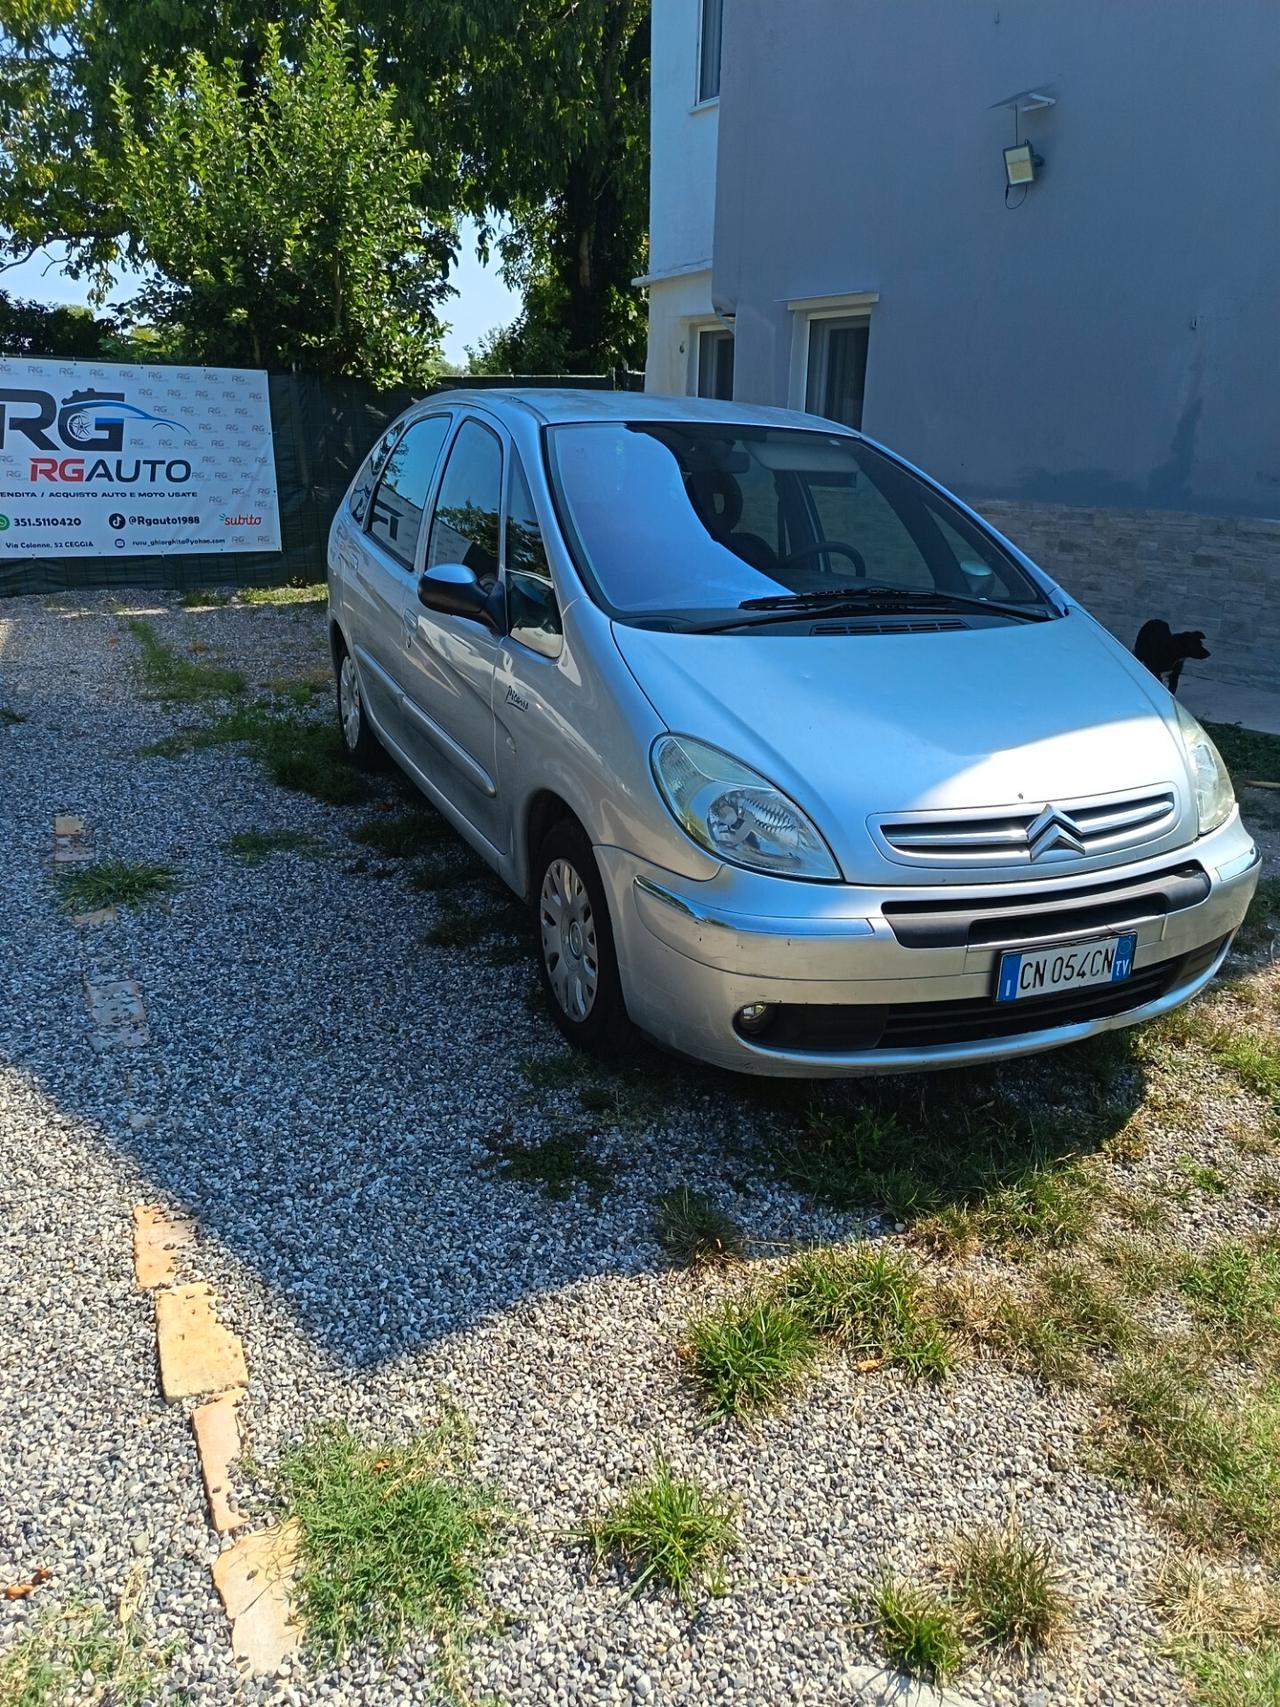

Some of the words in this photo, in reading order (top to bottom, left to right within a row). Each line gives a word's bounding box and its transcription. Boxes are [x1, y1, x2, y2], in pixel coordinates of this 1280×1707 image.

[28, 366, 43, 374] RG
[59, 367, 74, 375] RG
[90, 368, 104, 376] RG
[119, 370, 133, 378] RG
[148, 371, 162, 379] RG
[168, 389, 181, 397] RG
[181, 406, 194, 414] RG
[225, 424, 238, 432] RG
[130, 438, 144, 446] RG
[29, 458, 192, 483] RGAUTO
[14, 518, 82, 527] 351.5110420
[128, 515, 200, 527] @Rgauto1988
[224, 514, 262, 526] subito
[1115, 959, 1130, 976] TV
